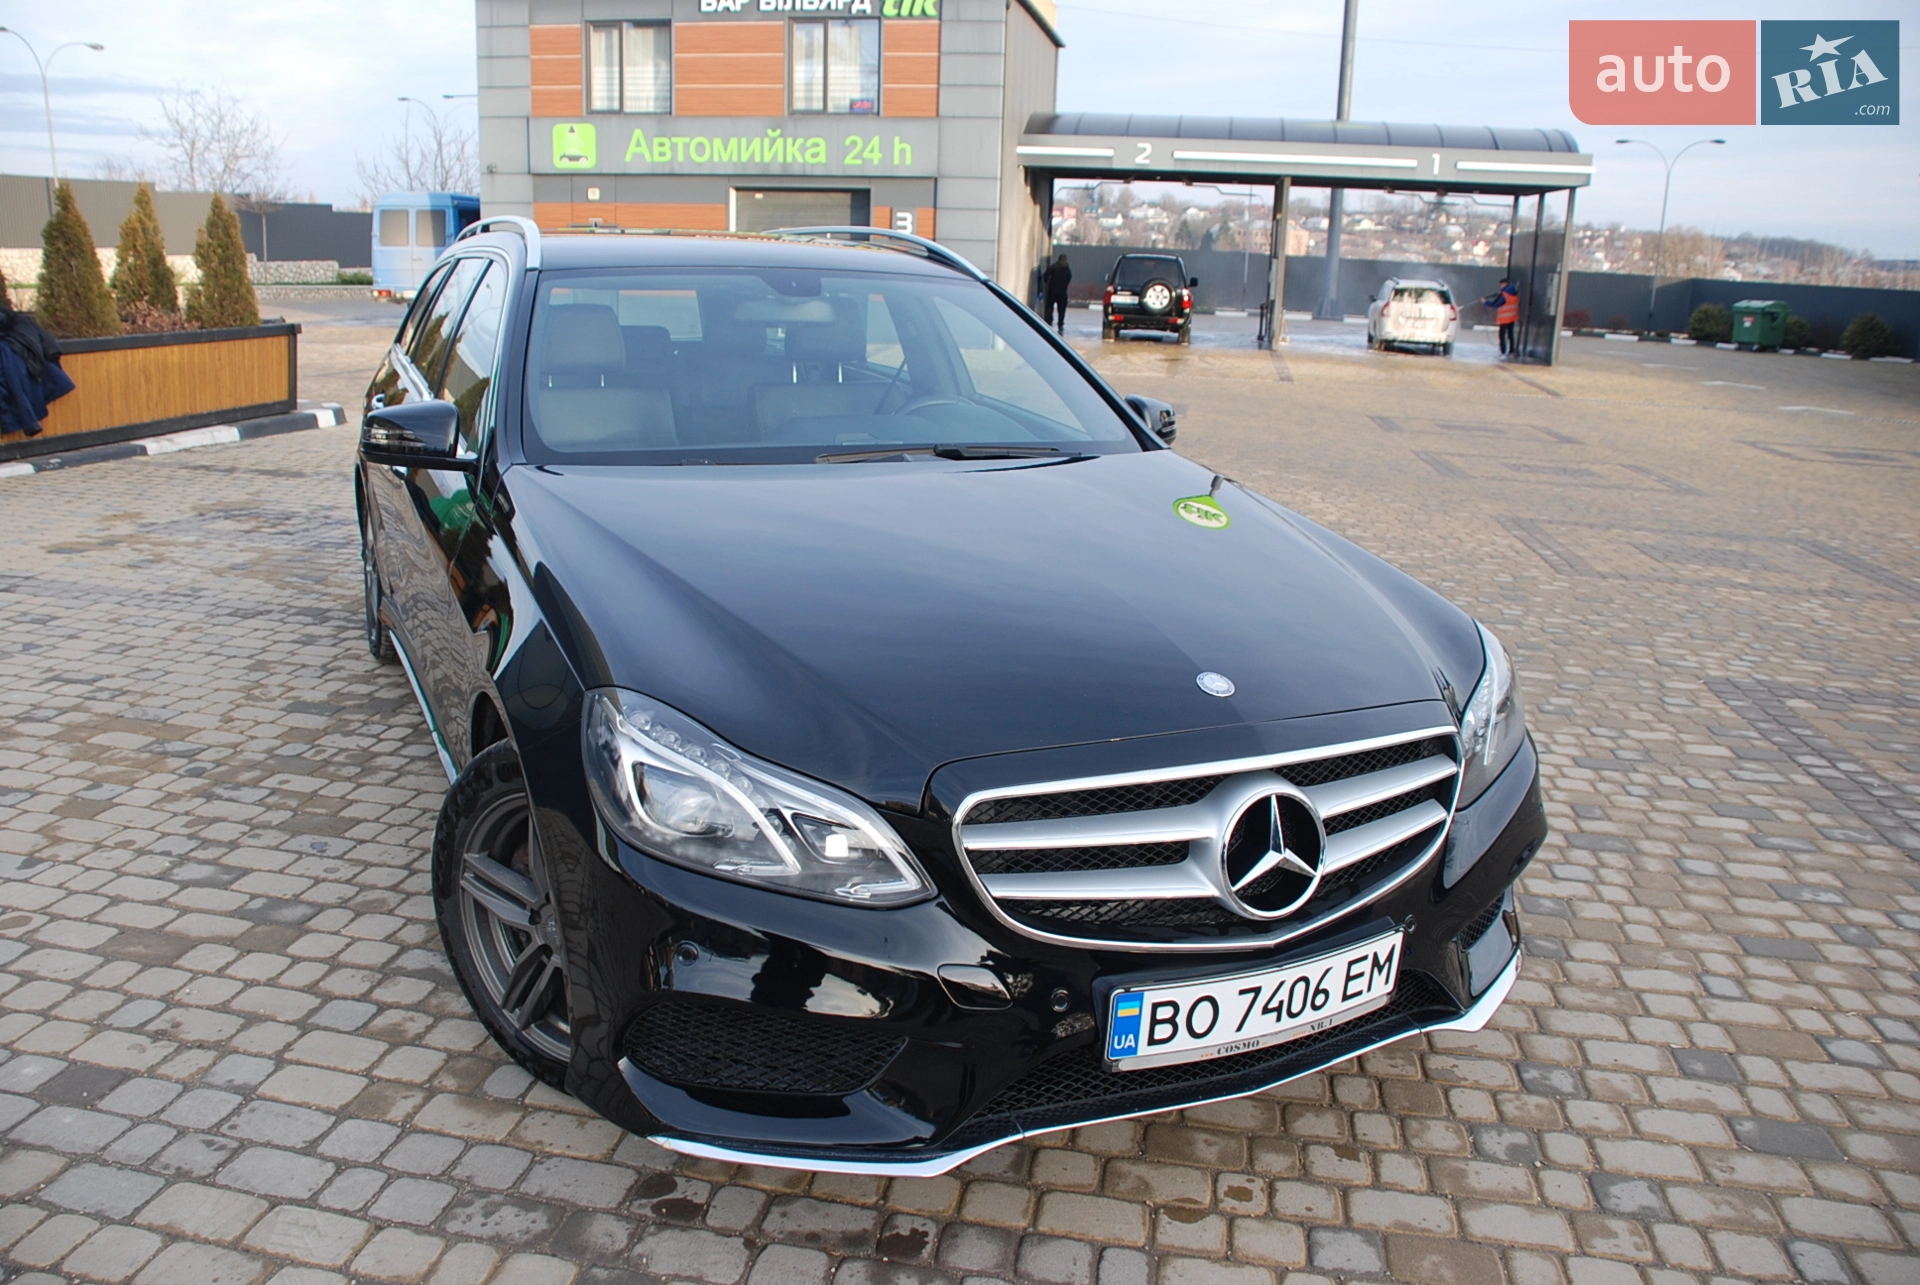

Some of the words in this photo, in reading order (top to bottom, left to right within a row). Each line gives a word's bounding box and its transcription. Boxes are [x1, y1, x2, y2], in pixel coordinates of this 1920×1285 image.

[624, 128, 827, 164] Автомийка
[843, 135, 883, 165] 24
[893, 136, 912, 166] h
[1135, 142, 1152, 164] 2
[1431, 153, 1440, 175] 1
[896, 212, 913, 235] 3
[1147, 994, 1220, 1046] BO
[1234, 966, 1334, 1033] 7406
[1341, 943, 1397, 1003] EM
[1113, 1033, 1136, 1050] UA
[1217, 1039, 1260, 1056] COSMO
